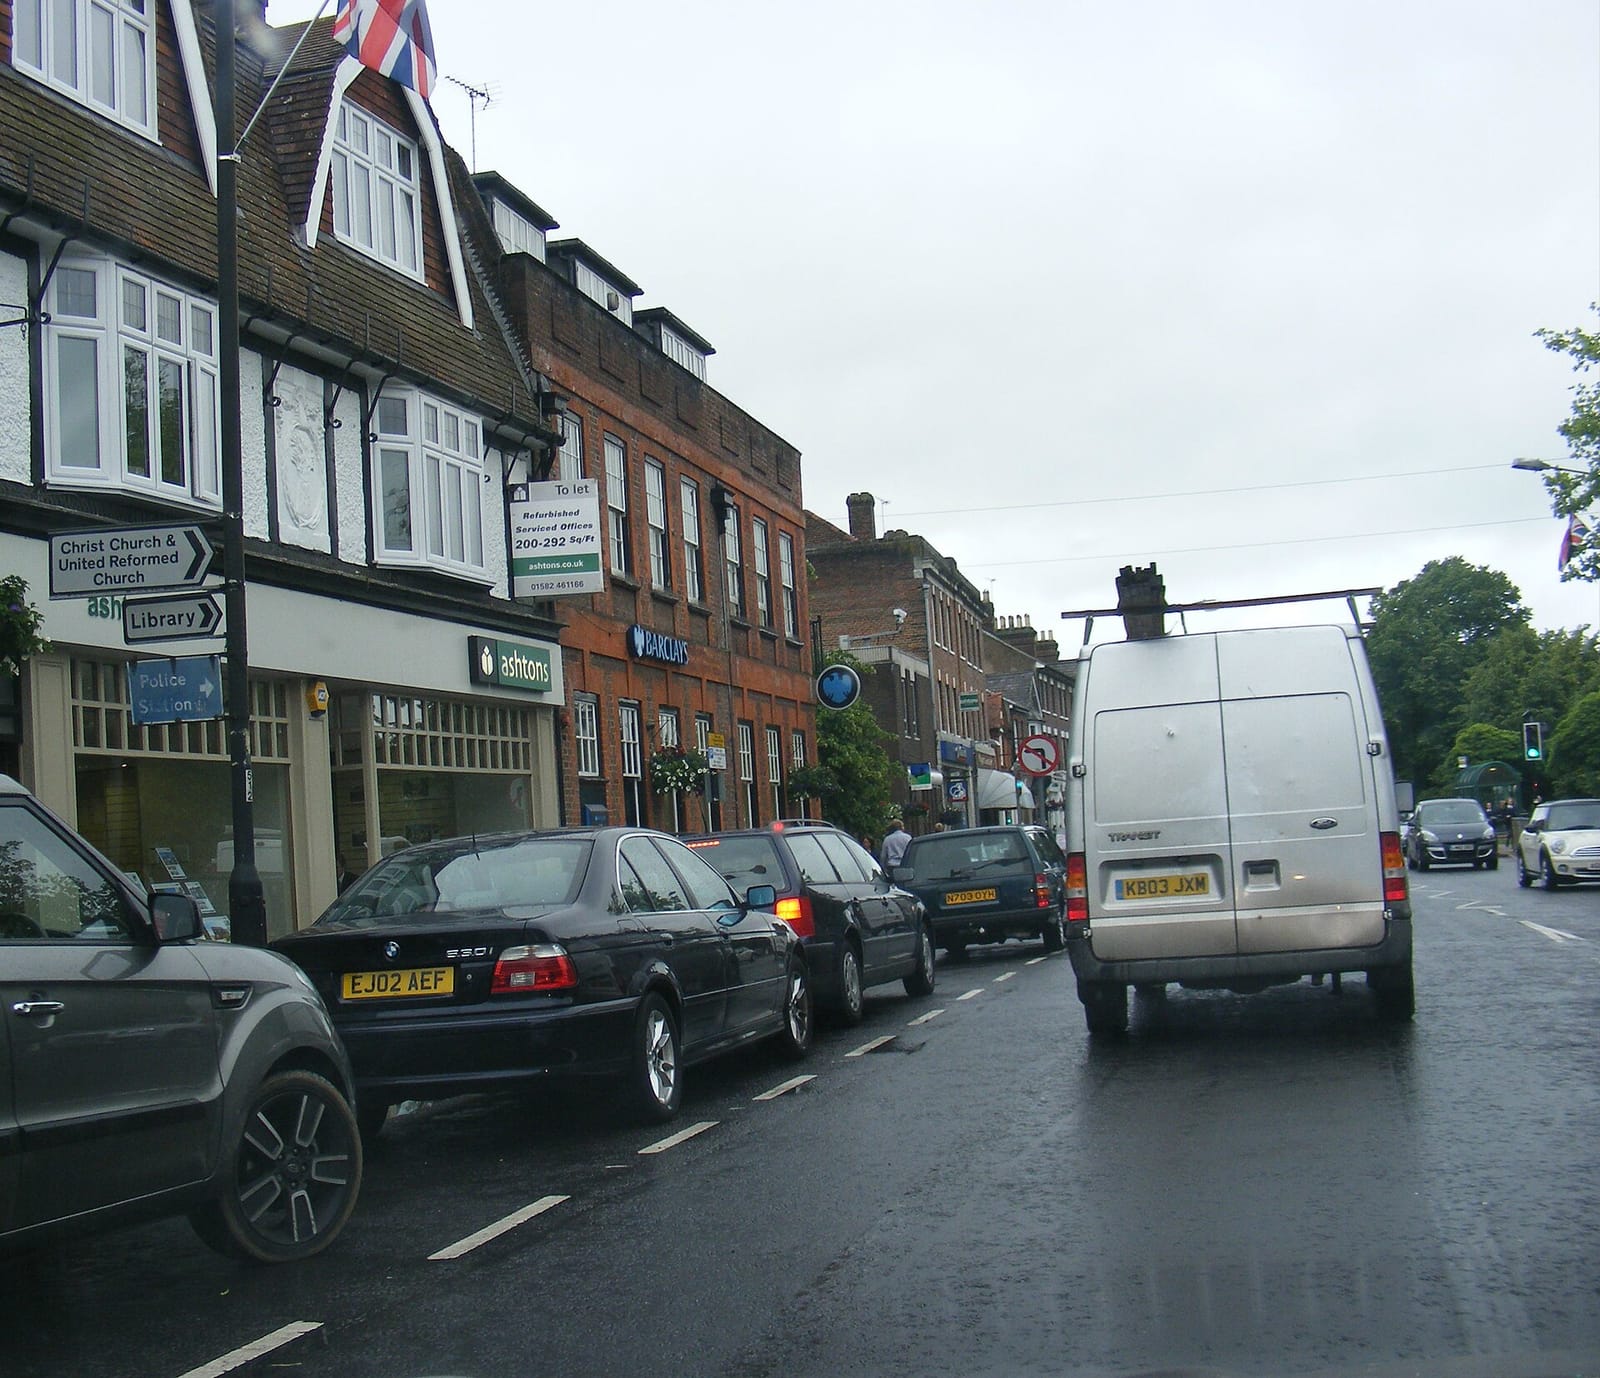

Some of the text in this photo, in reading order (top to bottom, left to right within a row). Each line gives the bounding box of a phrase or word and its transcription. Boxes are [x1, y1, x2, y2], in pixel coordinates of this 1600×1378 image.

[555, 484, 589, 495] To let
[523, 509, 580, 520] Refurbished
[516, 522, 593, 533] Serviced Offices
[61, 534, 176, 554] Christ Church &
[515, 535, 595, 549] 200-292 Sq/Ft
[58, 551, 179, 571] United Reformed
[528, 560, 584, 571] ashtons.co.uk
[93, 571, 145, 586] Church
[530, 581, 584, 591] 01582 461166
[87, 595, 123, 621] ash
[131, 612, 195, 630] Library
[645, 631, 689, 665] BARCLAYS
[501, 649, 549, 683] ashtons
[140, 673, 187, 688] Police
[1126, 879, 1169, 896] KB03
[947, 892, 973, 903] N703
[351, 970, 447, 994] EJ02 AEF
